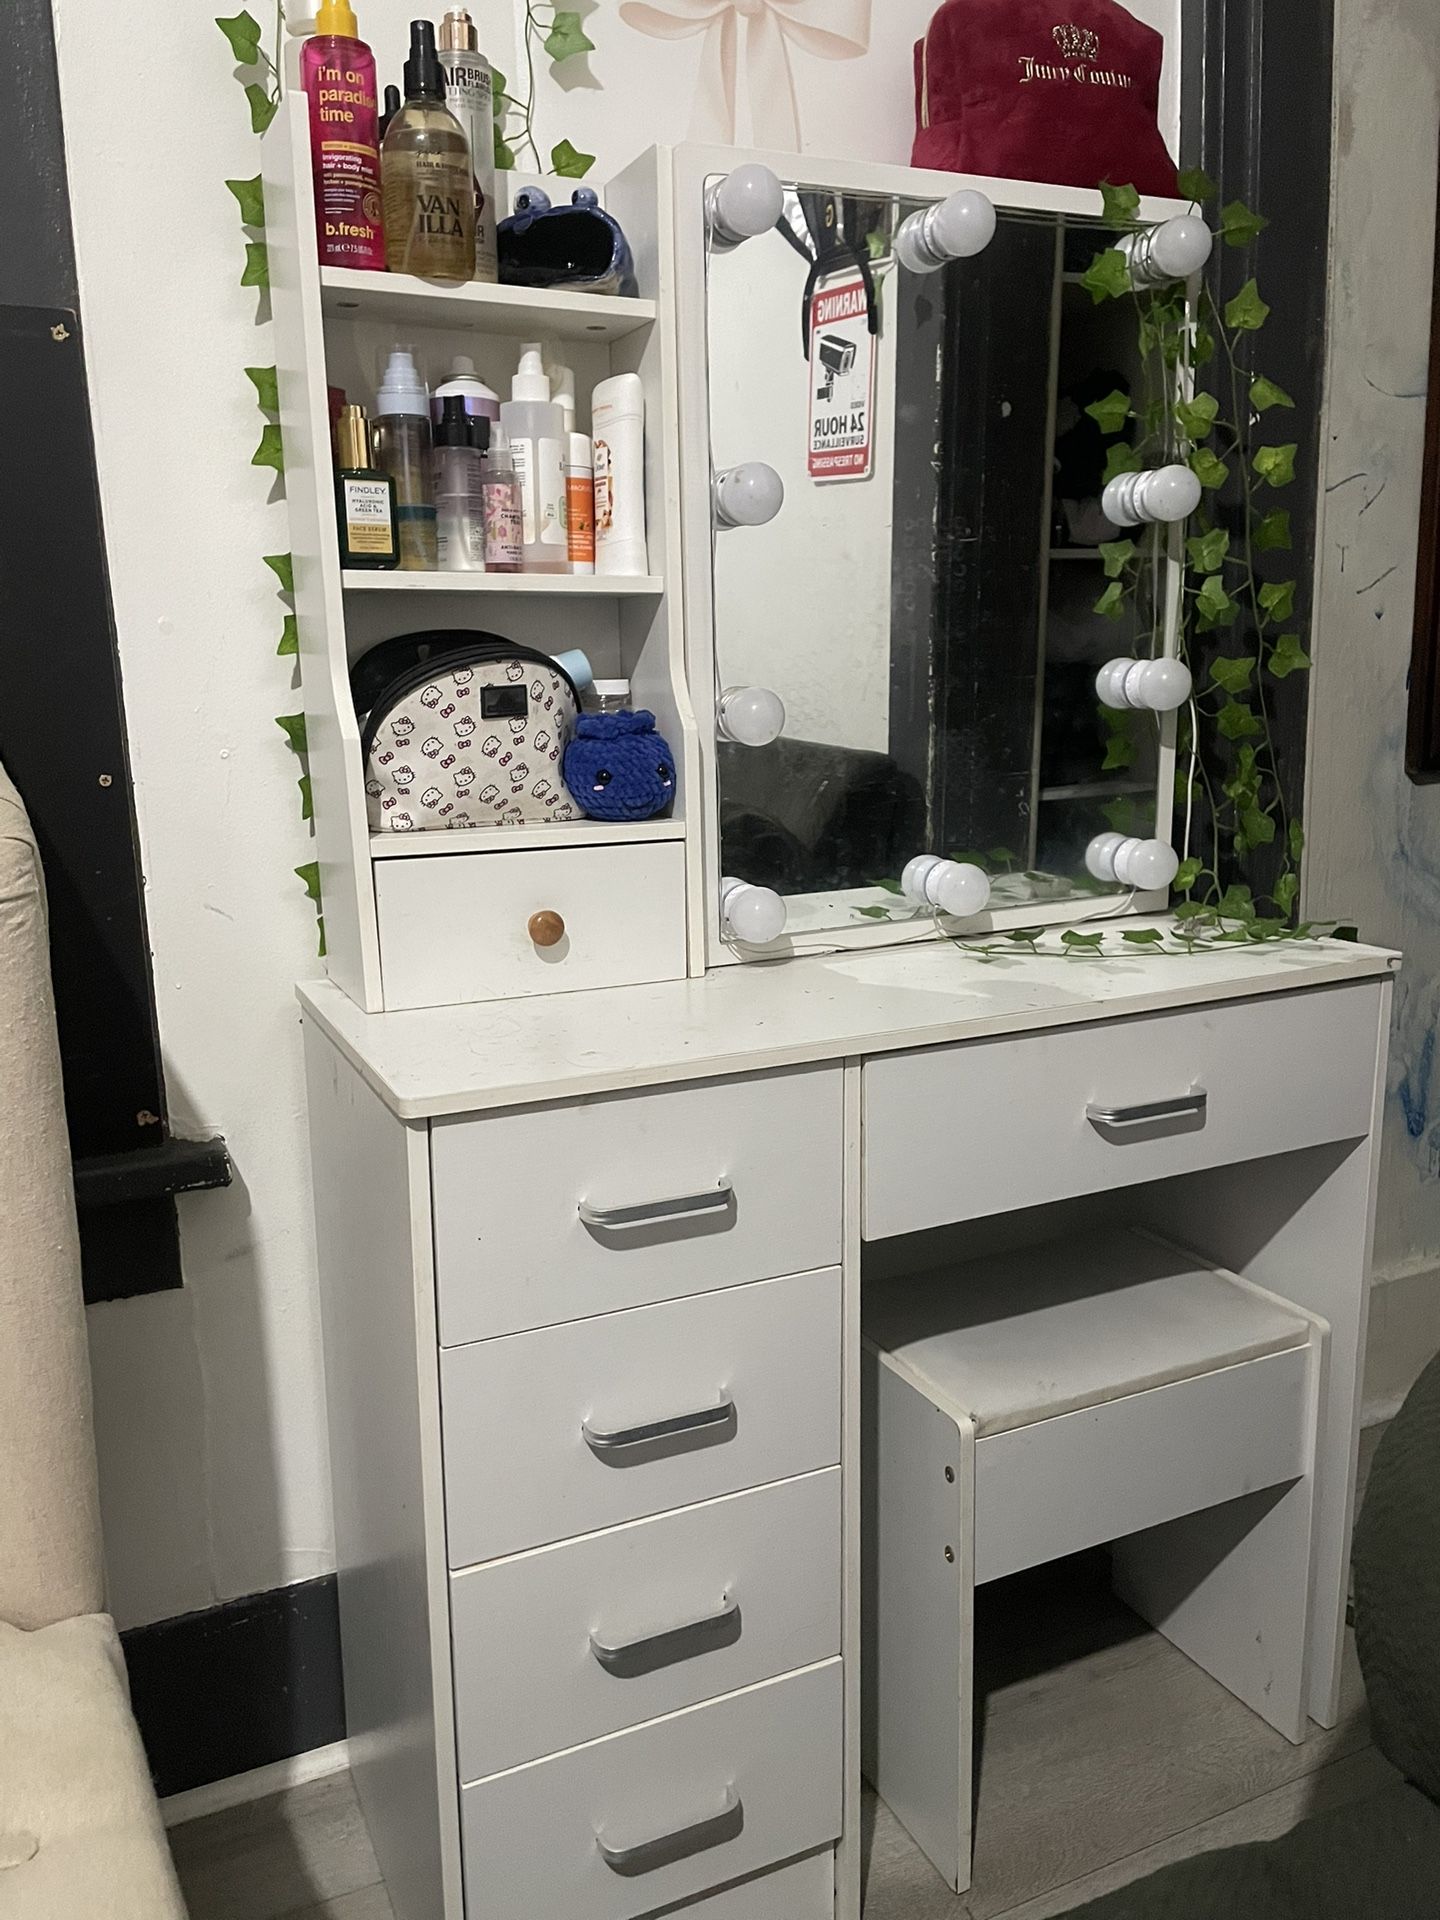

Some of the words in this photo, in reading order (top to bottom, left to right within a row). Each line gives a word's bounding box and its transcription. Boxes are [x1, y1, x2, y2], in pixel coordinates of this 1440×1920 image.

[318, 66, 341, 82] i'm
[345, 71, 365, 86] on
[1073, 63, 1132, 88] Coutu
[320, 106, 355, 123] time
[323, 162, 336, 170] hair
[343, 162, 361, 173] body
[416, 194, 461, 216] VAN
[325, 222, 375, 240] b.fresh
[419, 214, 465, 238] ILLA
[349, 486, 387, 495] FINDLEY
